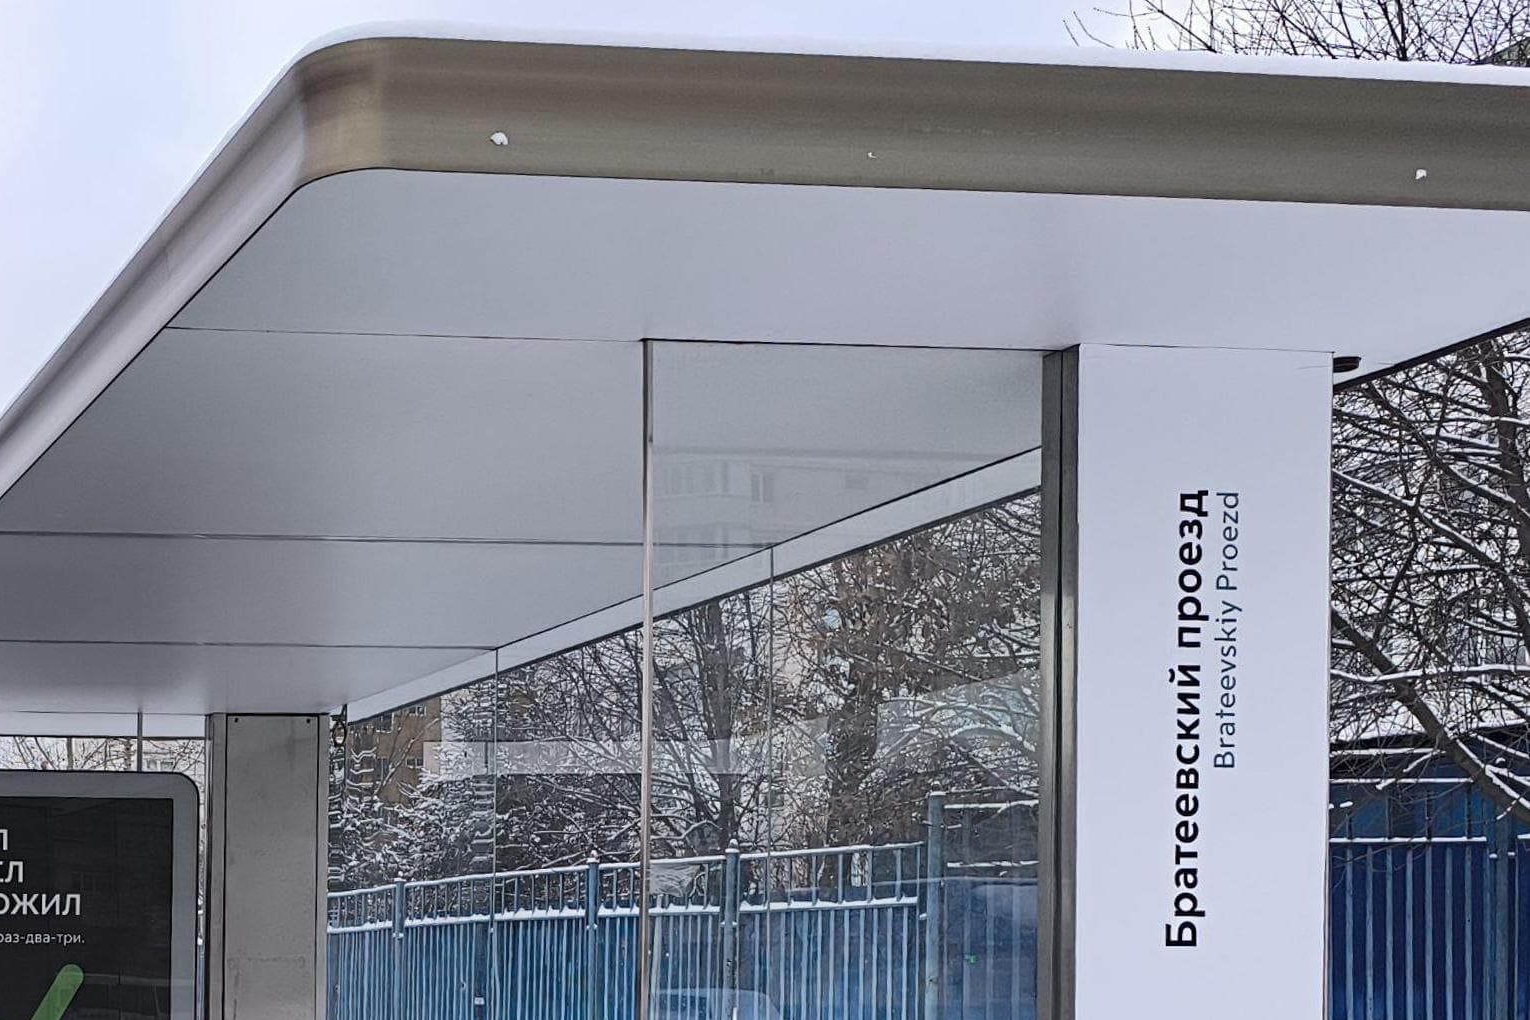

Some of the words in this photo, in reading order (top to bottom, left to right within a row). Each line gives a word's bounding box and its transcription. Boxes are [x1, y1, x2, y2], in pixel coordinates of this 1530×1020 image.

[1177, 490, 1209, 648] проезд
[1216, 492, 1239, 590] Proezd
[1214, 601, 1242, 769] Brateevskiy
[1165, 665, 1205, 946] Братеевский
